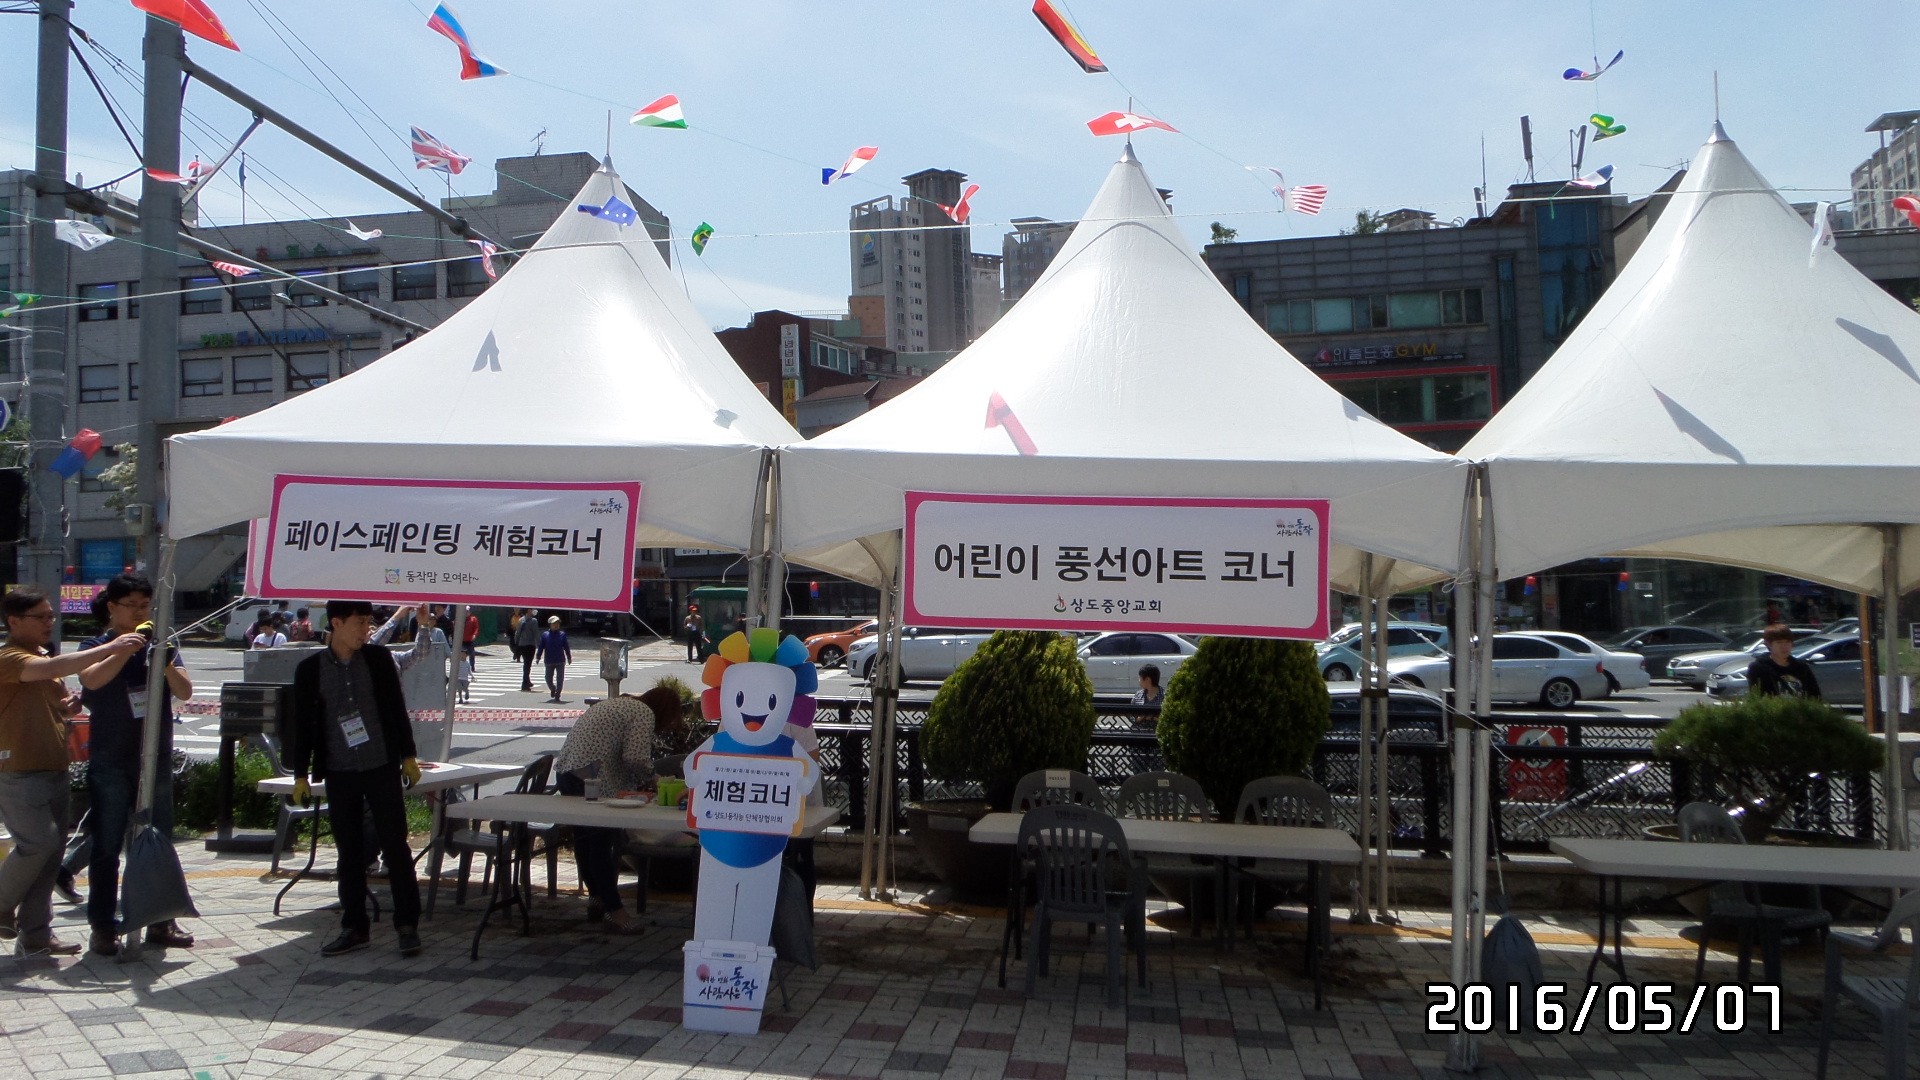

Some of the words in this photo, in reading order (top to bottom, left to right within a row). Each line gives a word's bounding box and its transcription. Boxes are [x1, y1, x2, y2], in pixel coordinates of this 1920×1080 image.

[284, 520, 462, 554] 페이스페인팅
[473, 524, 603, 560] 체험코너
[406, 570, 436, 584] 동작맘
[442, 571, 479, 585] 모여라~
[934, 543, 1039, 580] 어린이
[1055, 546, 1206, 583] 풍선아트
[1220, 550, 1295, 587] 코너
[1070, 598, 1162, 614] 상도중앙교회
[704, 780, 790, 806] 체험코너
[699, 985, 741, 1001] 사람사는
[730, 966, 758, 1000] 동작
